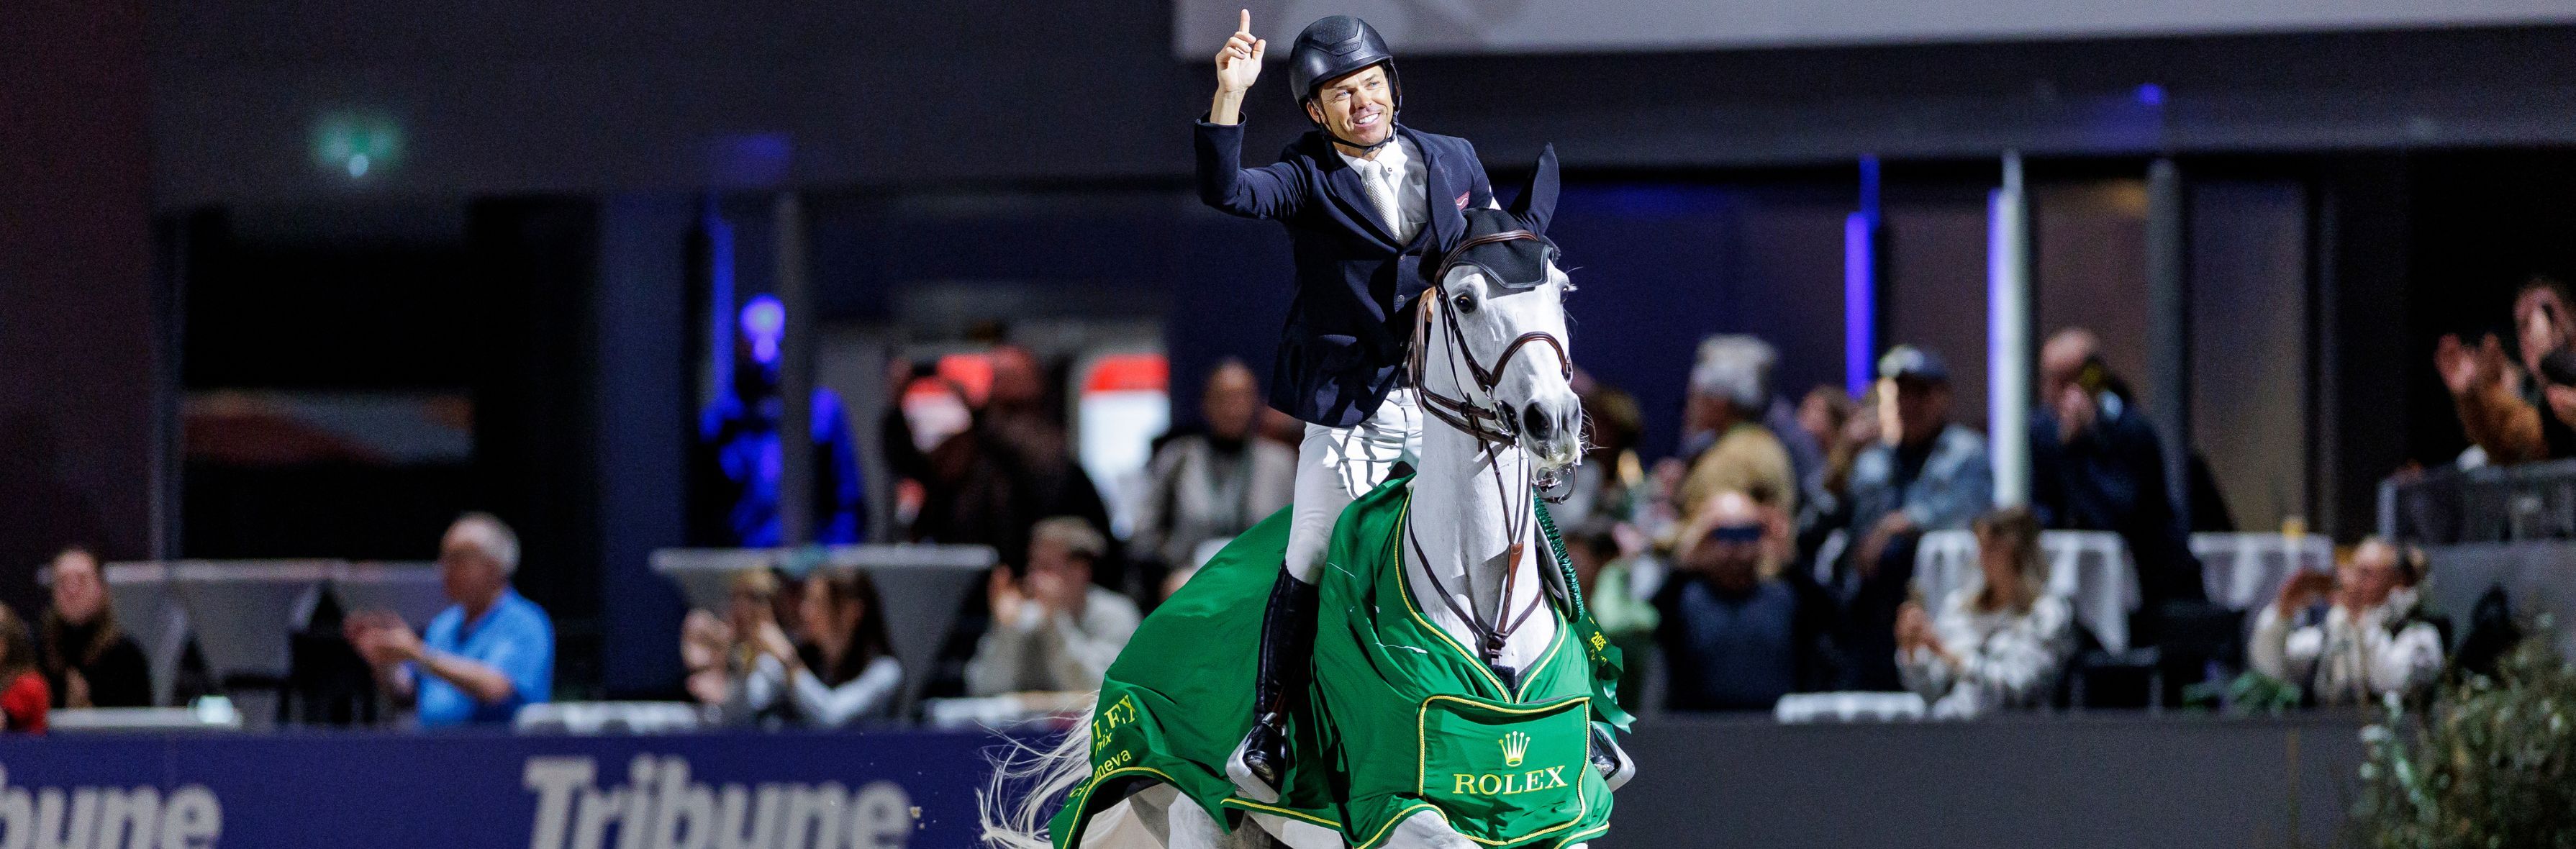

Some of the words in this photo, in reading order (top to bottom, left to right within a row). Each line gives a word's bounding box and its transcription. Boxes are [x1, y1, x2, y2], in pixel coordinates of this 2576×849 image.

[1091, 694, 1135, 745] LEX
[1093, 749, 1132, 782] eneva
[1452, 765, 1568, 795] ROLEX
[522, 753, 913, 849] Tribune
